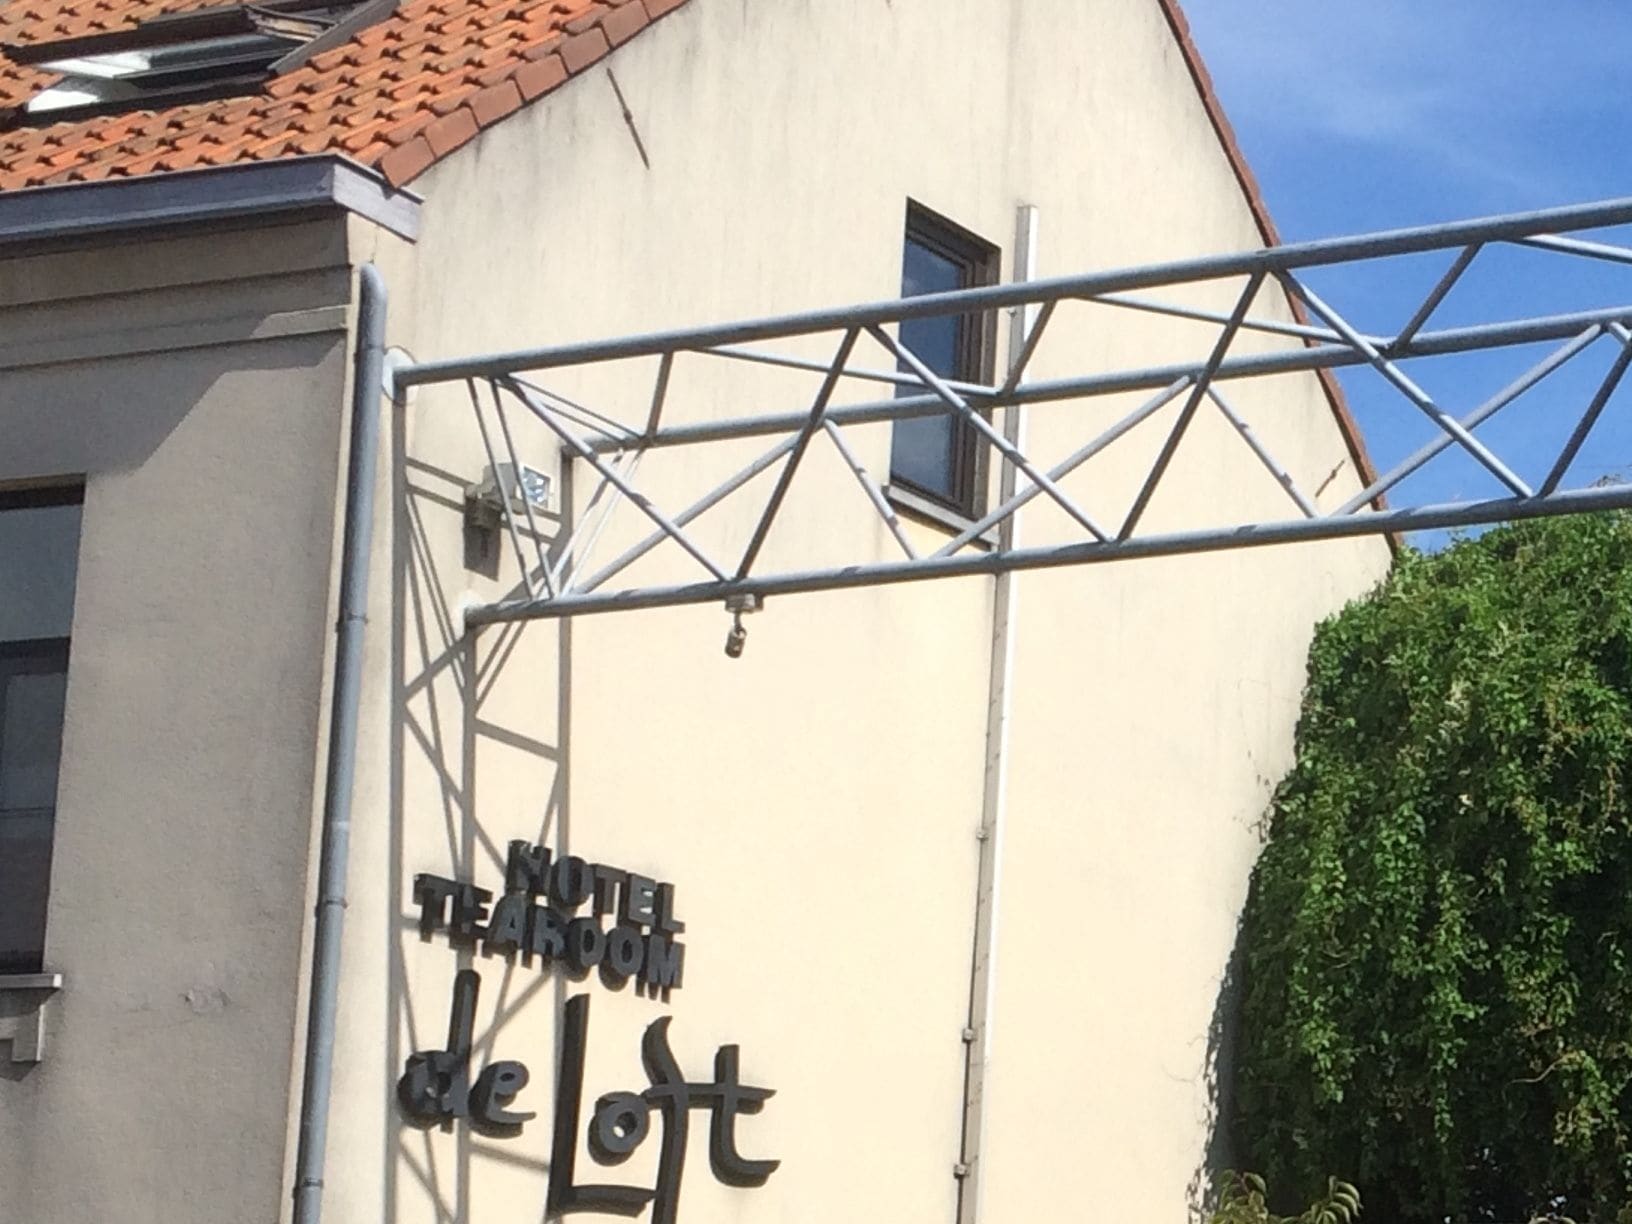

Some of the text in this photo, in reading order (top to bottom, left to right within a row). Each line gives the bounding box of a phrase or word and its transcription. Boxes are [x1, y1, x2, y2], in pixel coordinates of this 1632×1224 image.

[412, 872, 686, 1004] TEAROOM
[504, 838, 685, 935] HOTEL
[397, 968, 537, 1139] de
